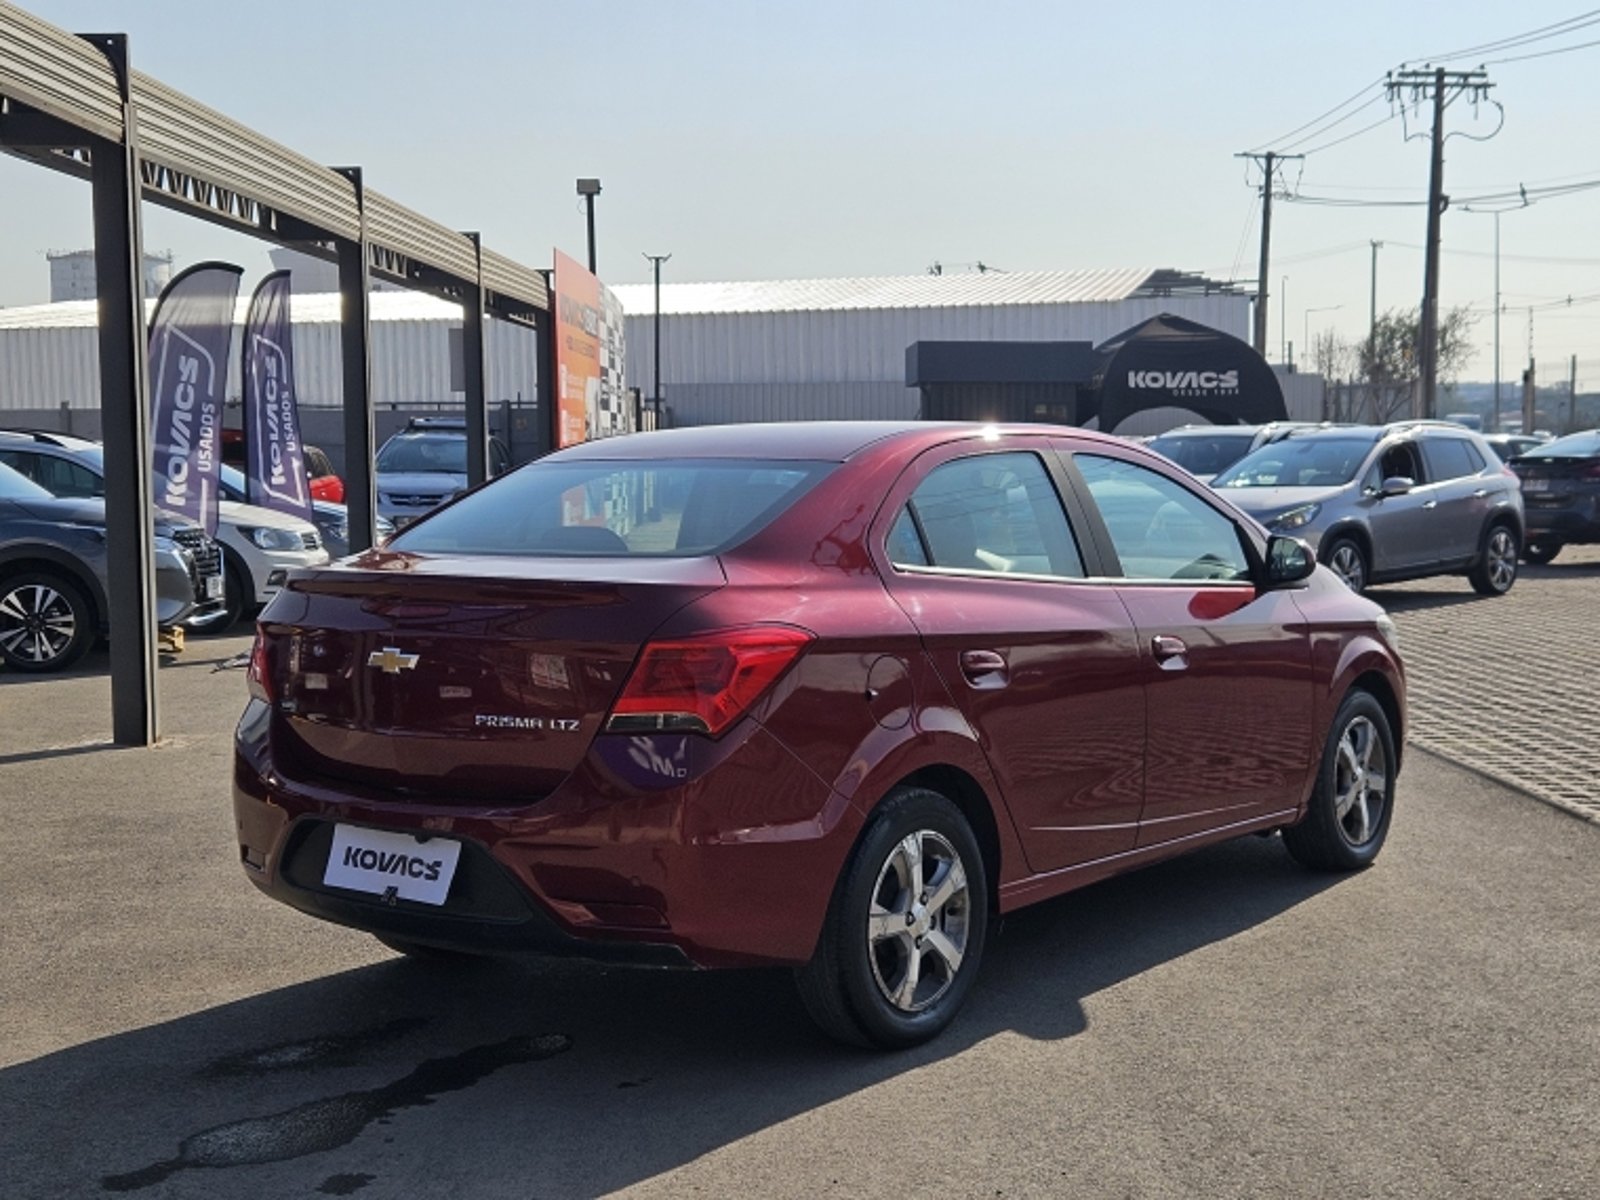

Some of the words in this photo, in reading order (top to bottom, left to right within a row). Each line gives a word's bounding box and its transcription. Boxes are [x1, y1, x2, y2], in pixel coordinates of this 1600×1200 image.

[1128, 370, 1239, 388] KOVACS
[165, 355, 199, 506] KOVACS
[198, 403, 215, 472] USADOS
[264, 355, 286, 485] KOVACS
[281, 391, 296, 452] USADOS
[475, 715, 542, 729] PRISMA
[550, 719, 580, 731] LTZ
[343, 845, 442, 881] KOVACS
